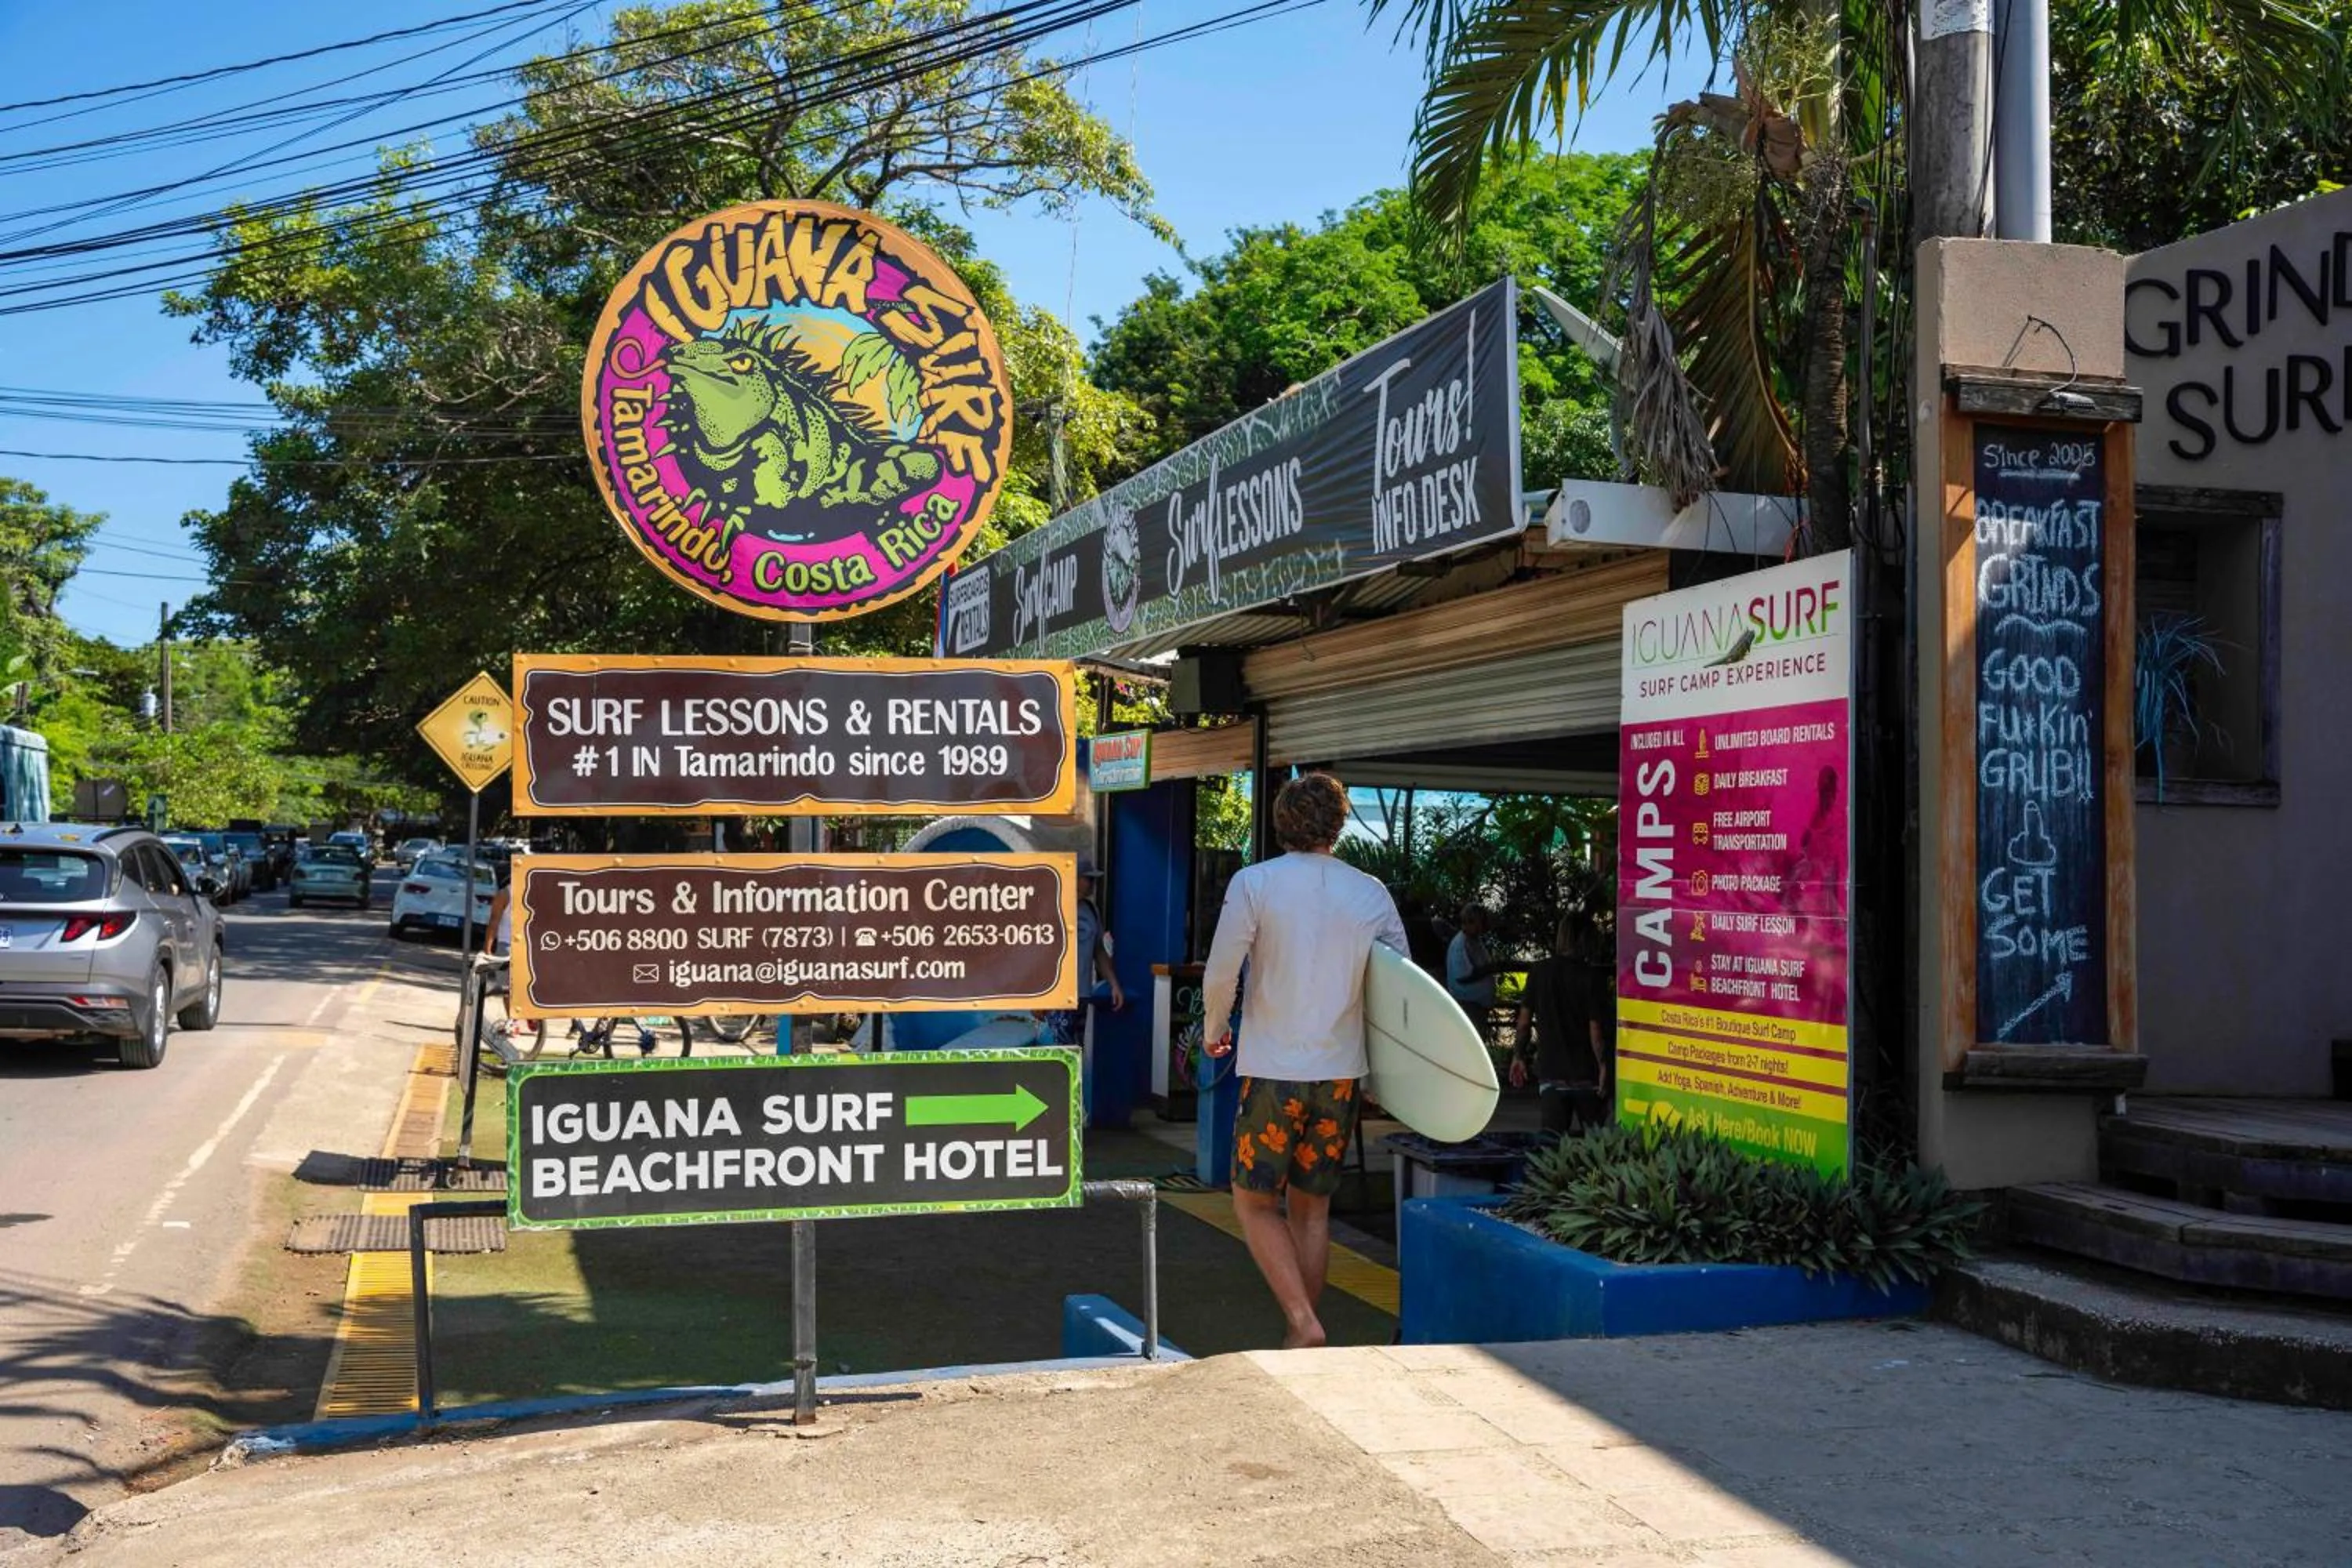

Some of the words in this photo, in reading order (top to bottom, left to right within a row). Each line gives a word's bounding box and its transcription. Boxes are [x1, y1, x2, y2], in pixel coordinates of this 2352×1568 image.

[644, 212, 880, 343] IGUANA
[880, 285, 996, 483] SURF
[1363, 307, 1477, 500] Tours!
[2166, 344, 2352, 461] SUR
[1984, 443, 2040, 469] Since
[1371, 480, 1417, 554] INFO
[1423, 455, 1481, 539] DESK
[1975, 497, 2102, 554] BREAKFAST
[755, 551, 874, 592] Costa
[878, 492, 960, 568] Rica
[1978, 552, 2101, 617] GRINDS
[1640, 677, 1675, 698] SURF
[1680, 670, 1720, 693] CAMP
[1726, 652, 1826, 686] EXPERIENCE
[1982, 648, 2081, 698] GOOD
[463, 695, 500, 706] CAUTION
[547, 697, 644, 737] SURF
[661, 698, 828, 737] LESSONS
[846, 699, 872, 735] &
[888, 698, 1042, 735] RENTALS
[1671, 729, 1685, 746] ALL
[1715, 731, 1759, 751] UNLIMITED
[1760, 727, 1791, 748] BOARD
[1792, 722, 1835, 742] RENTALS
[572, 746, 619, 777] #1
[633, 746, 661, 776] IN
[674, 745, 836, 777] Tamarindo
[849, 747, 925, 775] since
[938, 745, 1008, 776] 1989
[1713, 772, 1737, 789] DAILY
[1738, 768, 1788, 788] BREAKFAST
[1713, 811, 1733, 828] FREE
[1734, 810, 1771, 827] AIRPORT
[1712, 834, 1788, 851] TRANSPORTATION
[1635, 758, 1676, 989] CAMPS
[1712, 874, 1739, 891] PHOTO
[1740, 875, 1781, 892] PACKAGE
[557, 881, 655, 915] Tours
[672, 881, 698, 914] &
[713, 880, 909, 914] Information
[924, 879, 1035, 913] Center
[1982, 866, 2057, 918] GET
[564, 930, 622, 951] +506
[626, 928, 688, 950] 8800
[696, 927, 753, 949] SURF
[761, 926, 834, 949] (7873)
[880, 925, 934, 948] +506
[942, 924, 1055, 947] 2653-0613
[1711, 915, 1735, 931] DAILY
[1736, 916, 1758, 932] SURF
[1760, 916, 1795, 935] LESSON
[1984, 914, 2090, 967] SOME
[669, 959, 966, 986] iguana@iguanasurf.com
[1711, 953, 1731, 971] STAY
[1733, 955, 1744, 971] AT
[1744, 956, 1777, 975] IGUANA
[1780, 960, 1805, 978] SURF
[1711, 977, 1766, 998] BEACHFRONT
[1770, 982, 1800, 1001] HOTEL
[1752, 1021, 1769, 1036] Surf
[1771, 1025, 1796, 1044] Camp
[1668, 1041, 1690, 1058] Camp
[1657, 1069, 1671, 1083] Add
[531, 1098, 742, 1145] IGUANA
[761, 1092, 893, 1134] SURF
[1784, 1128, 1817, 1158] NOW
[531, 1144, 886, 1198] BEACHFRONT
[902, 1138, 1064, 1181] HOTEL
